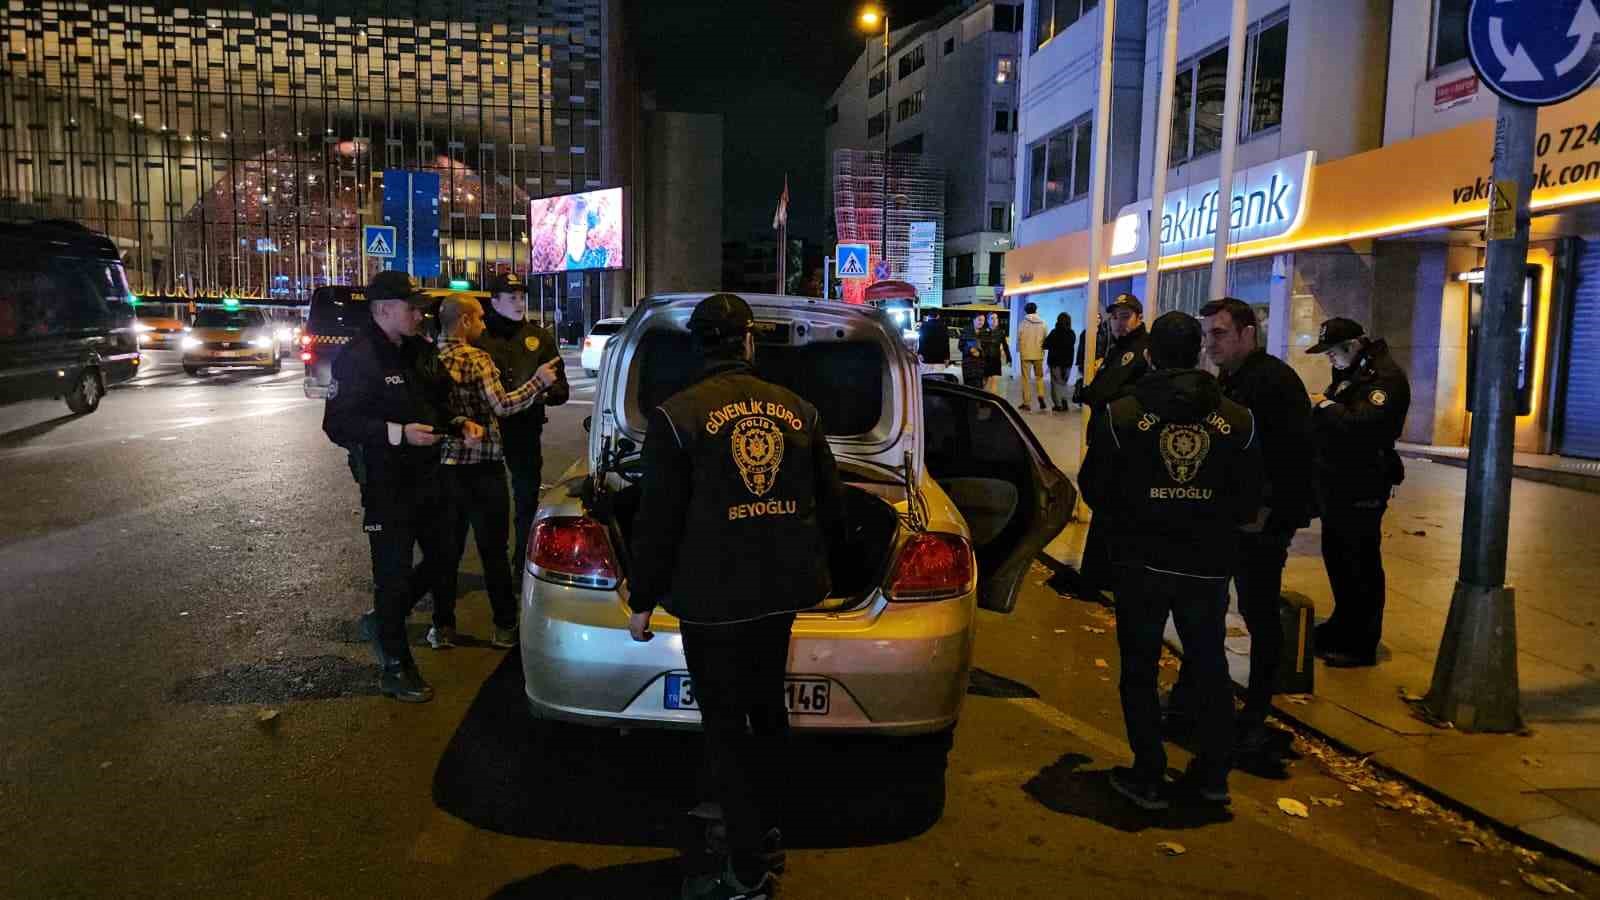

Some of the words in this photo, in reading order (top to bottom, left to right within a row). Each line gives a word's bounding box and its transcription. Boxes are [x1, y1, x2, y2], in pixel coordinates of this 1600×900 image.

[385, 376, 403, 384] POL
[706, 398, 763, 434] GÜVENLİK
[766, 402, 802, 431] BÜRO
[1206, 411, 1231, 434] ÜRO
[1150, 486, 1212, 500] BEYOĞLU
[728, 498, 796, 520] BEYOĞLU
[681, 679, 694, 706] 3
[786, 684, 826, 711] 146
